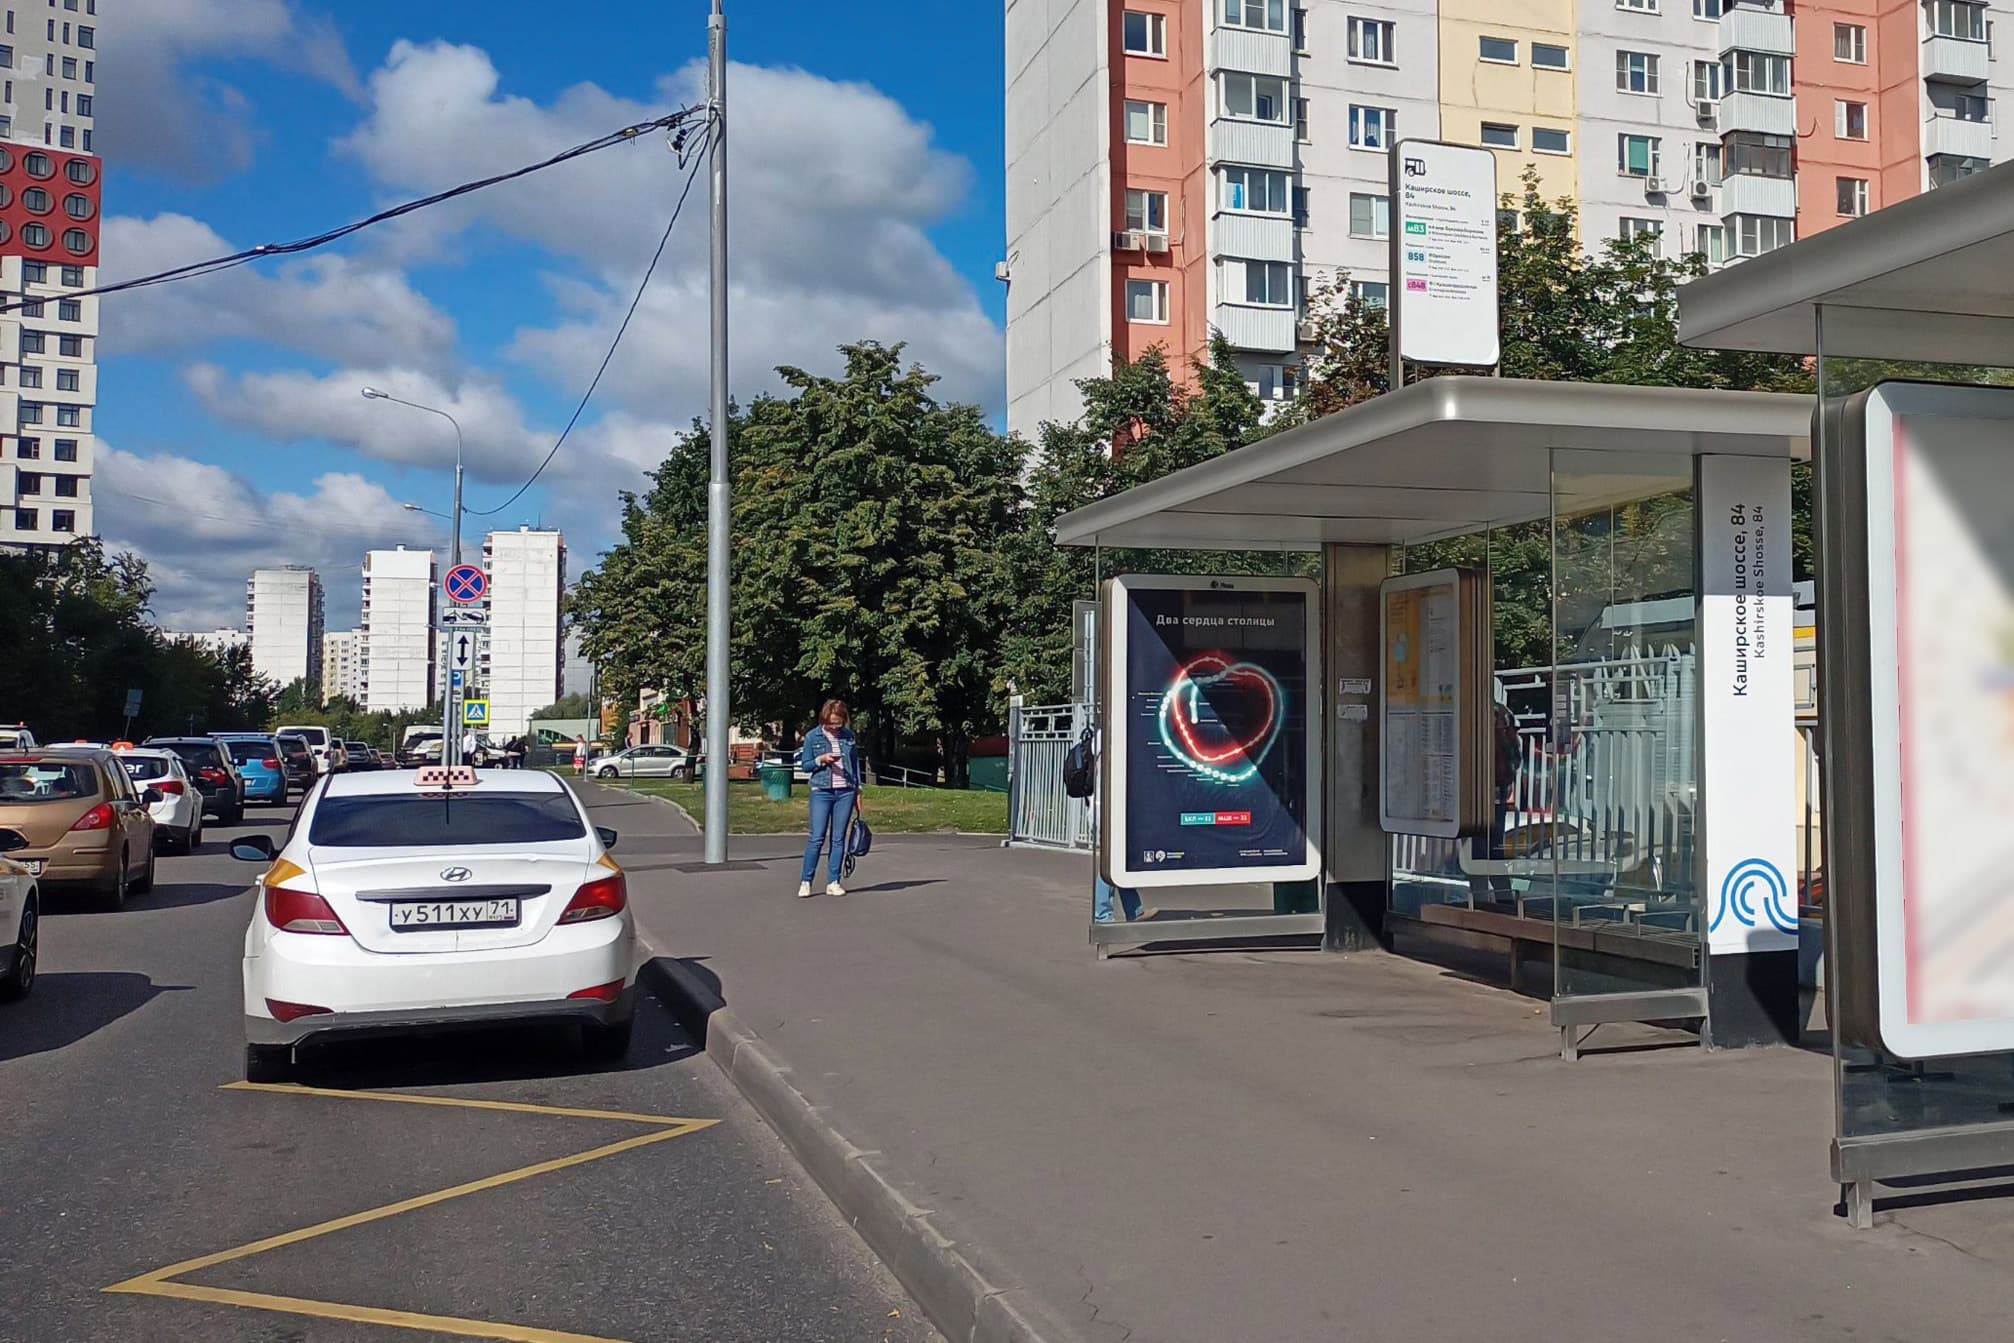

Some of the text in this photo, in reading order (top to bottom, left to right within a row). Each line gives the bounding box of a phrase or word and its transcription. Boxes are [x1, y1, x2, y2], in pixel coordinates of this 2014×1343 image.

[1405, 184, 1471, 198] Каширское шоссе,
[1408, 252, 1424, 261] 858
[1752, 505, 1765, 658] Kashirskoe Shosse, 84
[1731, 504, 1750, 696] Каширское шоссе, 84
[1156, 614, 1275, 627] Два сердца столицы
[124, 764, 144, 774] er
[490, 901, 510, 915] 71
